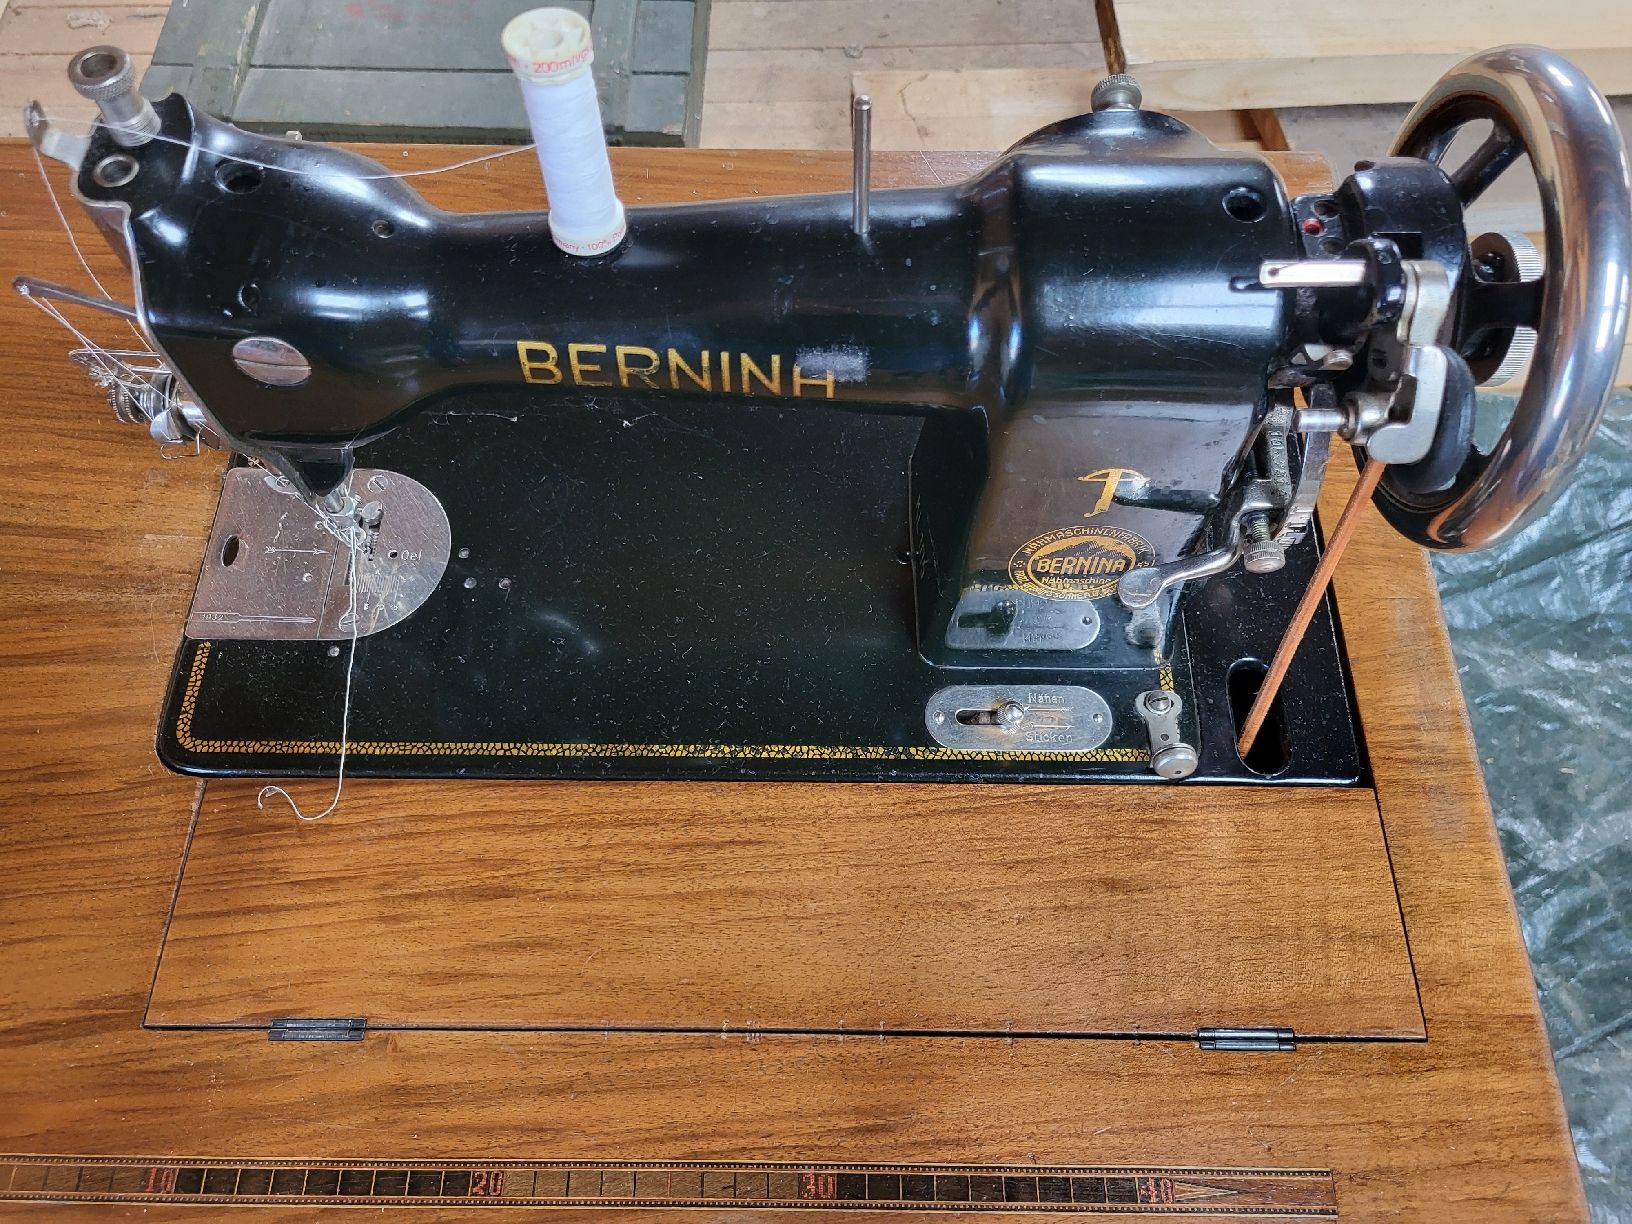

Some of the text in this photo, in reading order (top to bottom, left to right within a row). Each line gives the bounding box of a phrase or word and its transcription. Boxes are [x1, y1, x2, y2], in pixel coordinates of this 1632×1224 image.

[516, 340, 835, 399] BERNINA
[1036, 556, 1126, 576] BERNINA
[1028, 693, 1066, 704] Nähen
[1025, 731, 1073, 743] Sticken
[472, 1170, 502, 1196] 20
